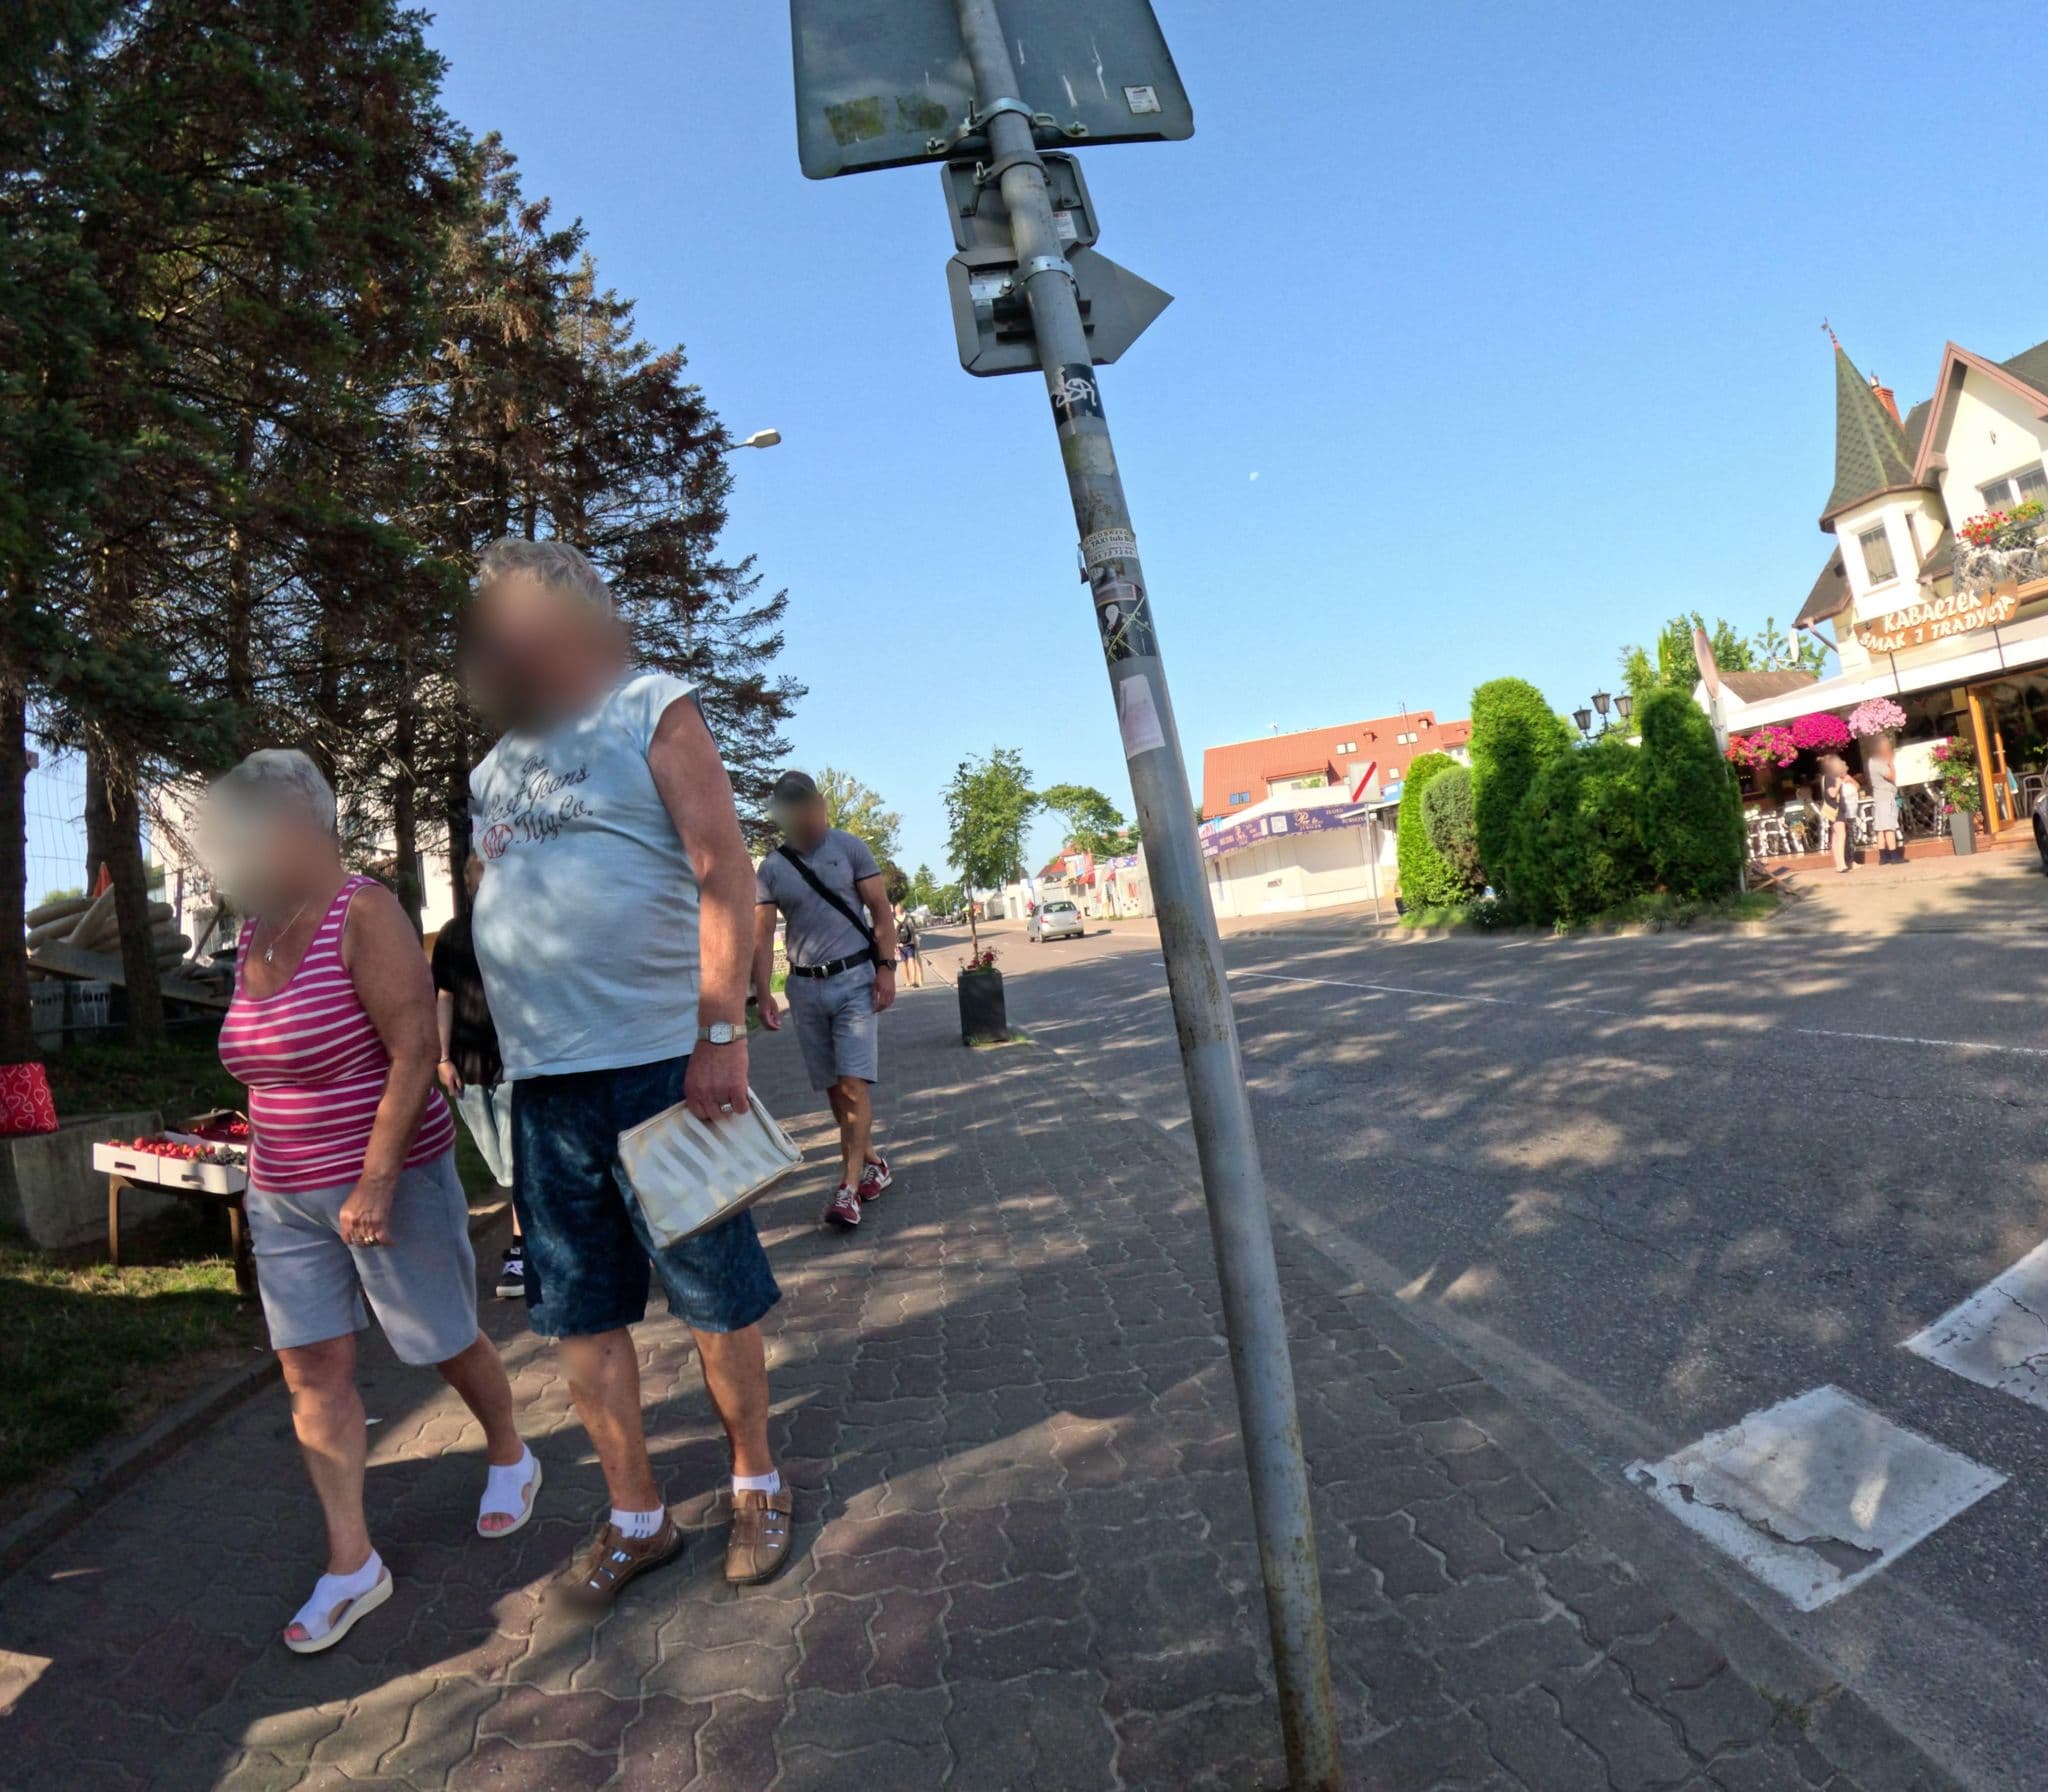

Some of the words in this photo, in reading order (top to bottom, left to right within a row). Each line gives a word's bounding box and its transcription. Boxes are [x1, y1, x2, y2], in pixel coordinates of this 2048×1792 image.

[1860, 630, 1907, 652] SMAK
[1931, 595, 2016, 640] TRADYCJA
[1883, 589, 1983, 634] KABACZEK
[527, 763, 591, 813] Jeans
[558, 794, 594, 822] Co.
